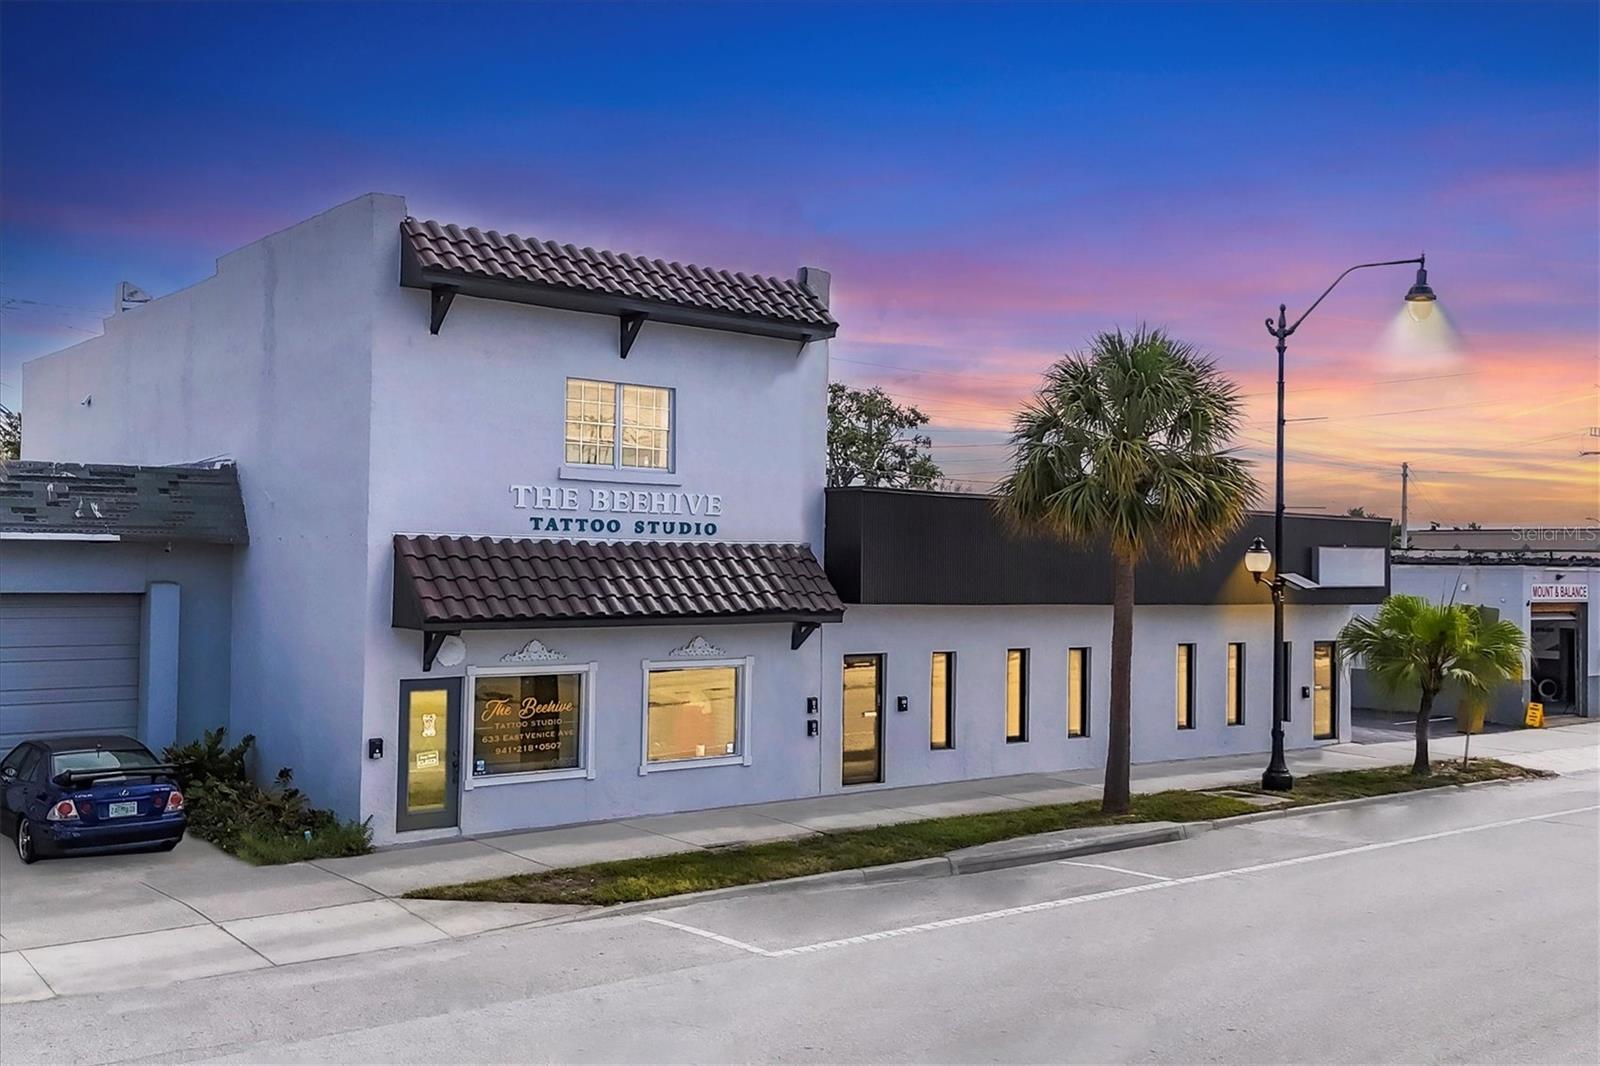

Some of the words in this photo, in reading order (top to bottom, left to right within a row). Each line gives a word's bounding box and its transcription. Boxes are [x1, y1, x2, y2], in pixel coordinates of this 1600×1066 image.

[510, 485, 578, 511] THE
[589, 488, 722, 517] BEEHIVE
[530, 517, 621, 533] TATTOO
[634, 520, 718, 536] STUDIO
[1533, 585, 1554, 597] MOUNT
[1555, 586, 1560, 597] &
[1560, 586, 1587, 597] BALANCE
[481, 698, 512, 721] The
[519, 697, 575, 719] Beehive
[494, 721, 529, 730] TATTOO
[531, 719, 563, 727] STUDIO
[524, 730, 556, 740] VENICE
